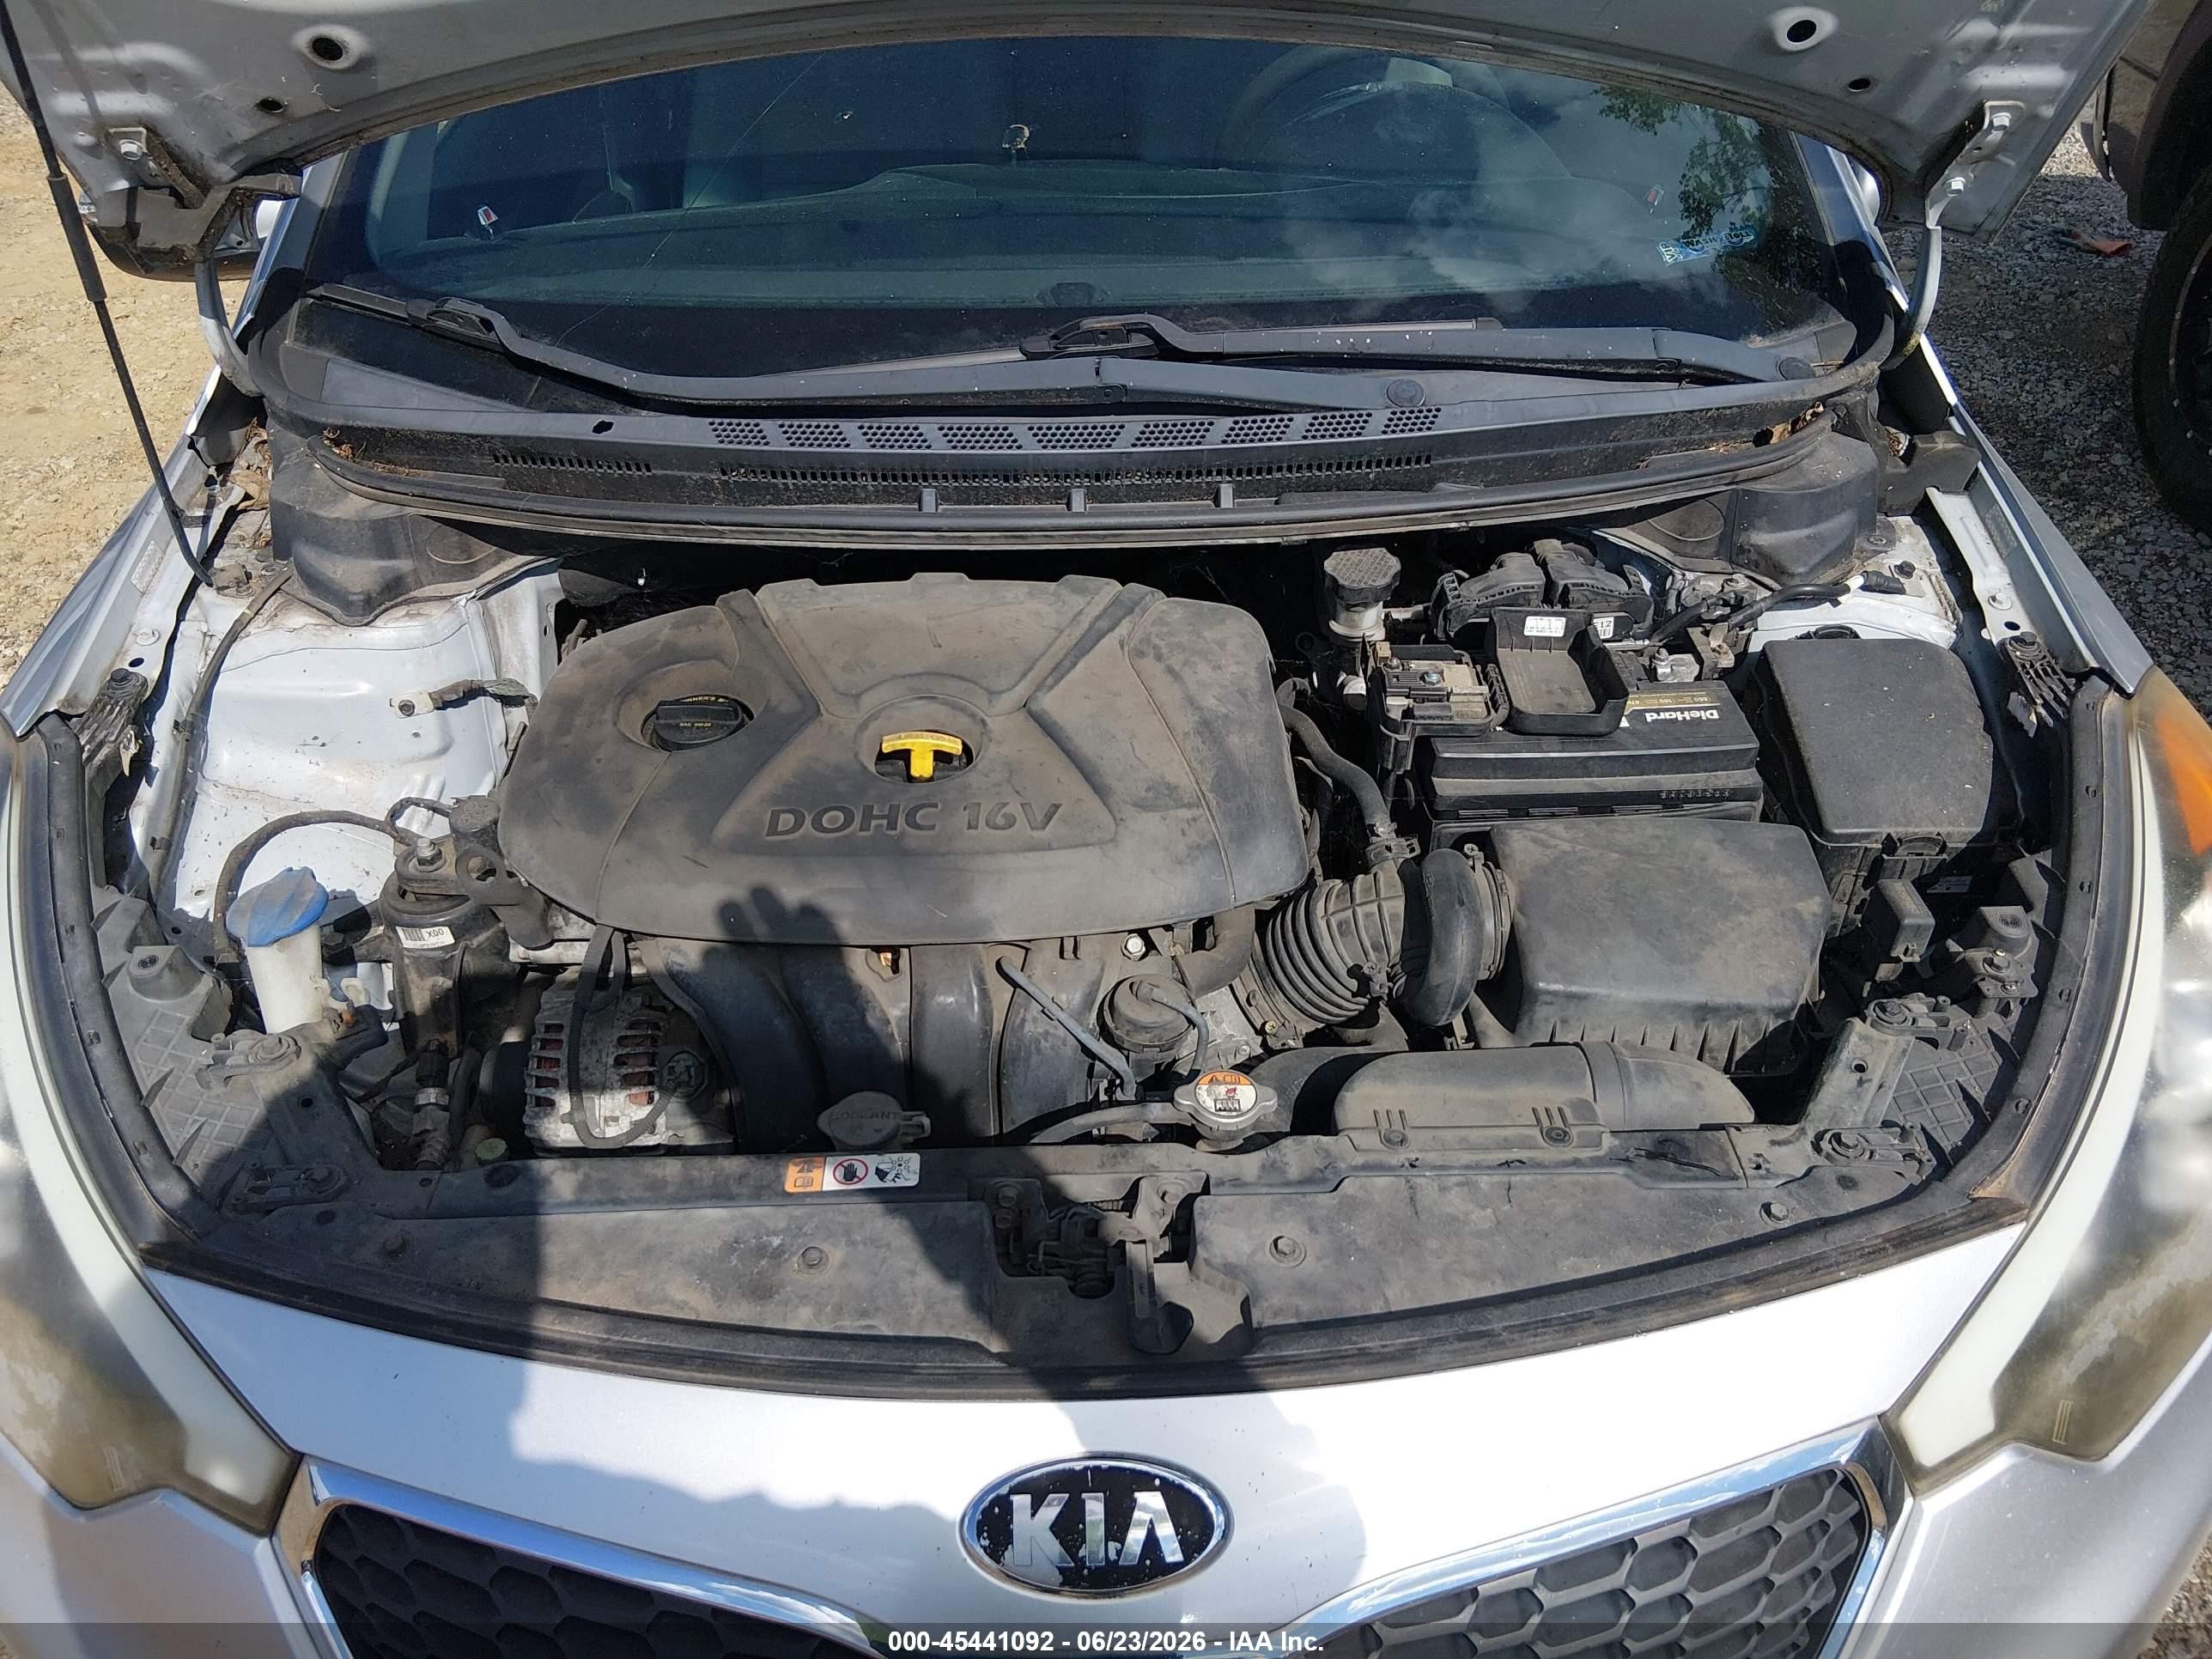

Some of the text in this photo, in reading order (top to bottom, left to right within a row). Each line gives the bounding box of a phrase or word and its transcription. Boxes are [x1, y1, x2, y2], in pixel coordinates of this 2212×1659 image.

[1645, 709, 1720, 722] DieHard
[765, 802, 1062, 837] DOHC 16V
[1010, 1491, 1184, 1566] KIA
